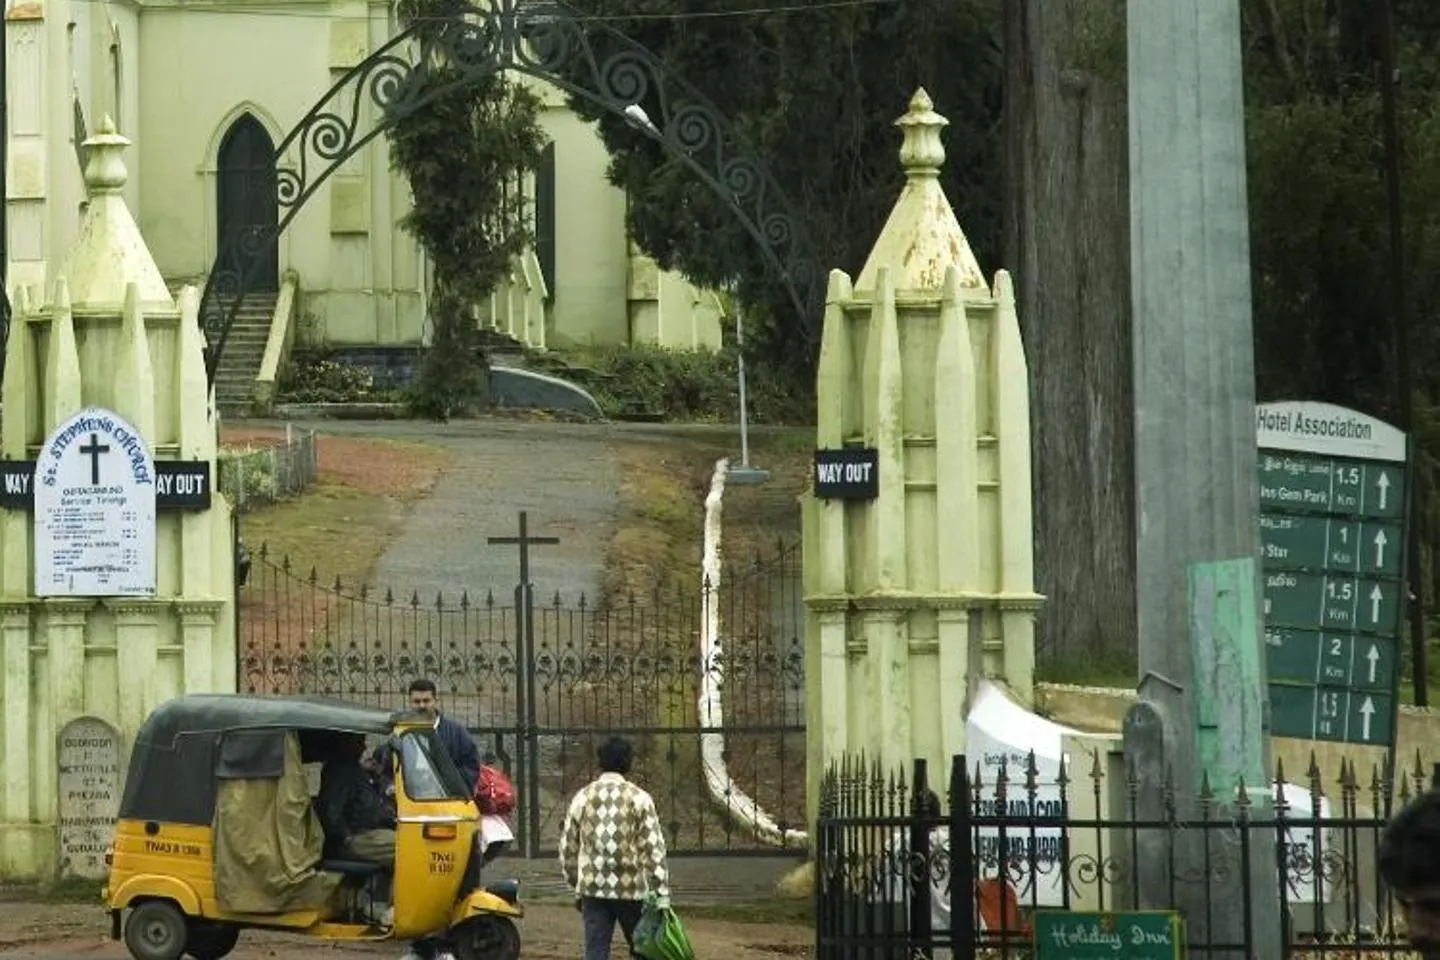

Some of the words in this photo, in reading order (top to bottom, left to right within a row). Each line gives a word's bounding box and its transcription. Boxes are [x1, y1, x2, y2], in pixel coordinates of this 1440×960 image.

[1258, 409, 1291, 432] Hotel
[1294, 412, 1372, 440] Association
[817, 463, 843, 483] WAY
[846, 462, 872, 483] OUT
[1337, 468, 1359, 484] 1.5
[156, 474, 172, 494] AY
[175, 474, 204, 494] OUT
[1304, 489, 1328, 504] Park
[1340, 527, 1348, 543] 1
[1267, 544, 1288, 558] Star
[1328, 581, 1352, 600] 1.5
[1331, 638, 1341, 656] 2
[1325, 666, 1345, 677] Km
[1051, 922, 1122, 949] Holiday
[1131, 924, 1172, 945] Inn
